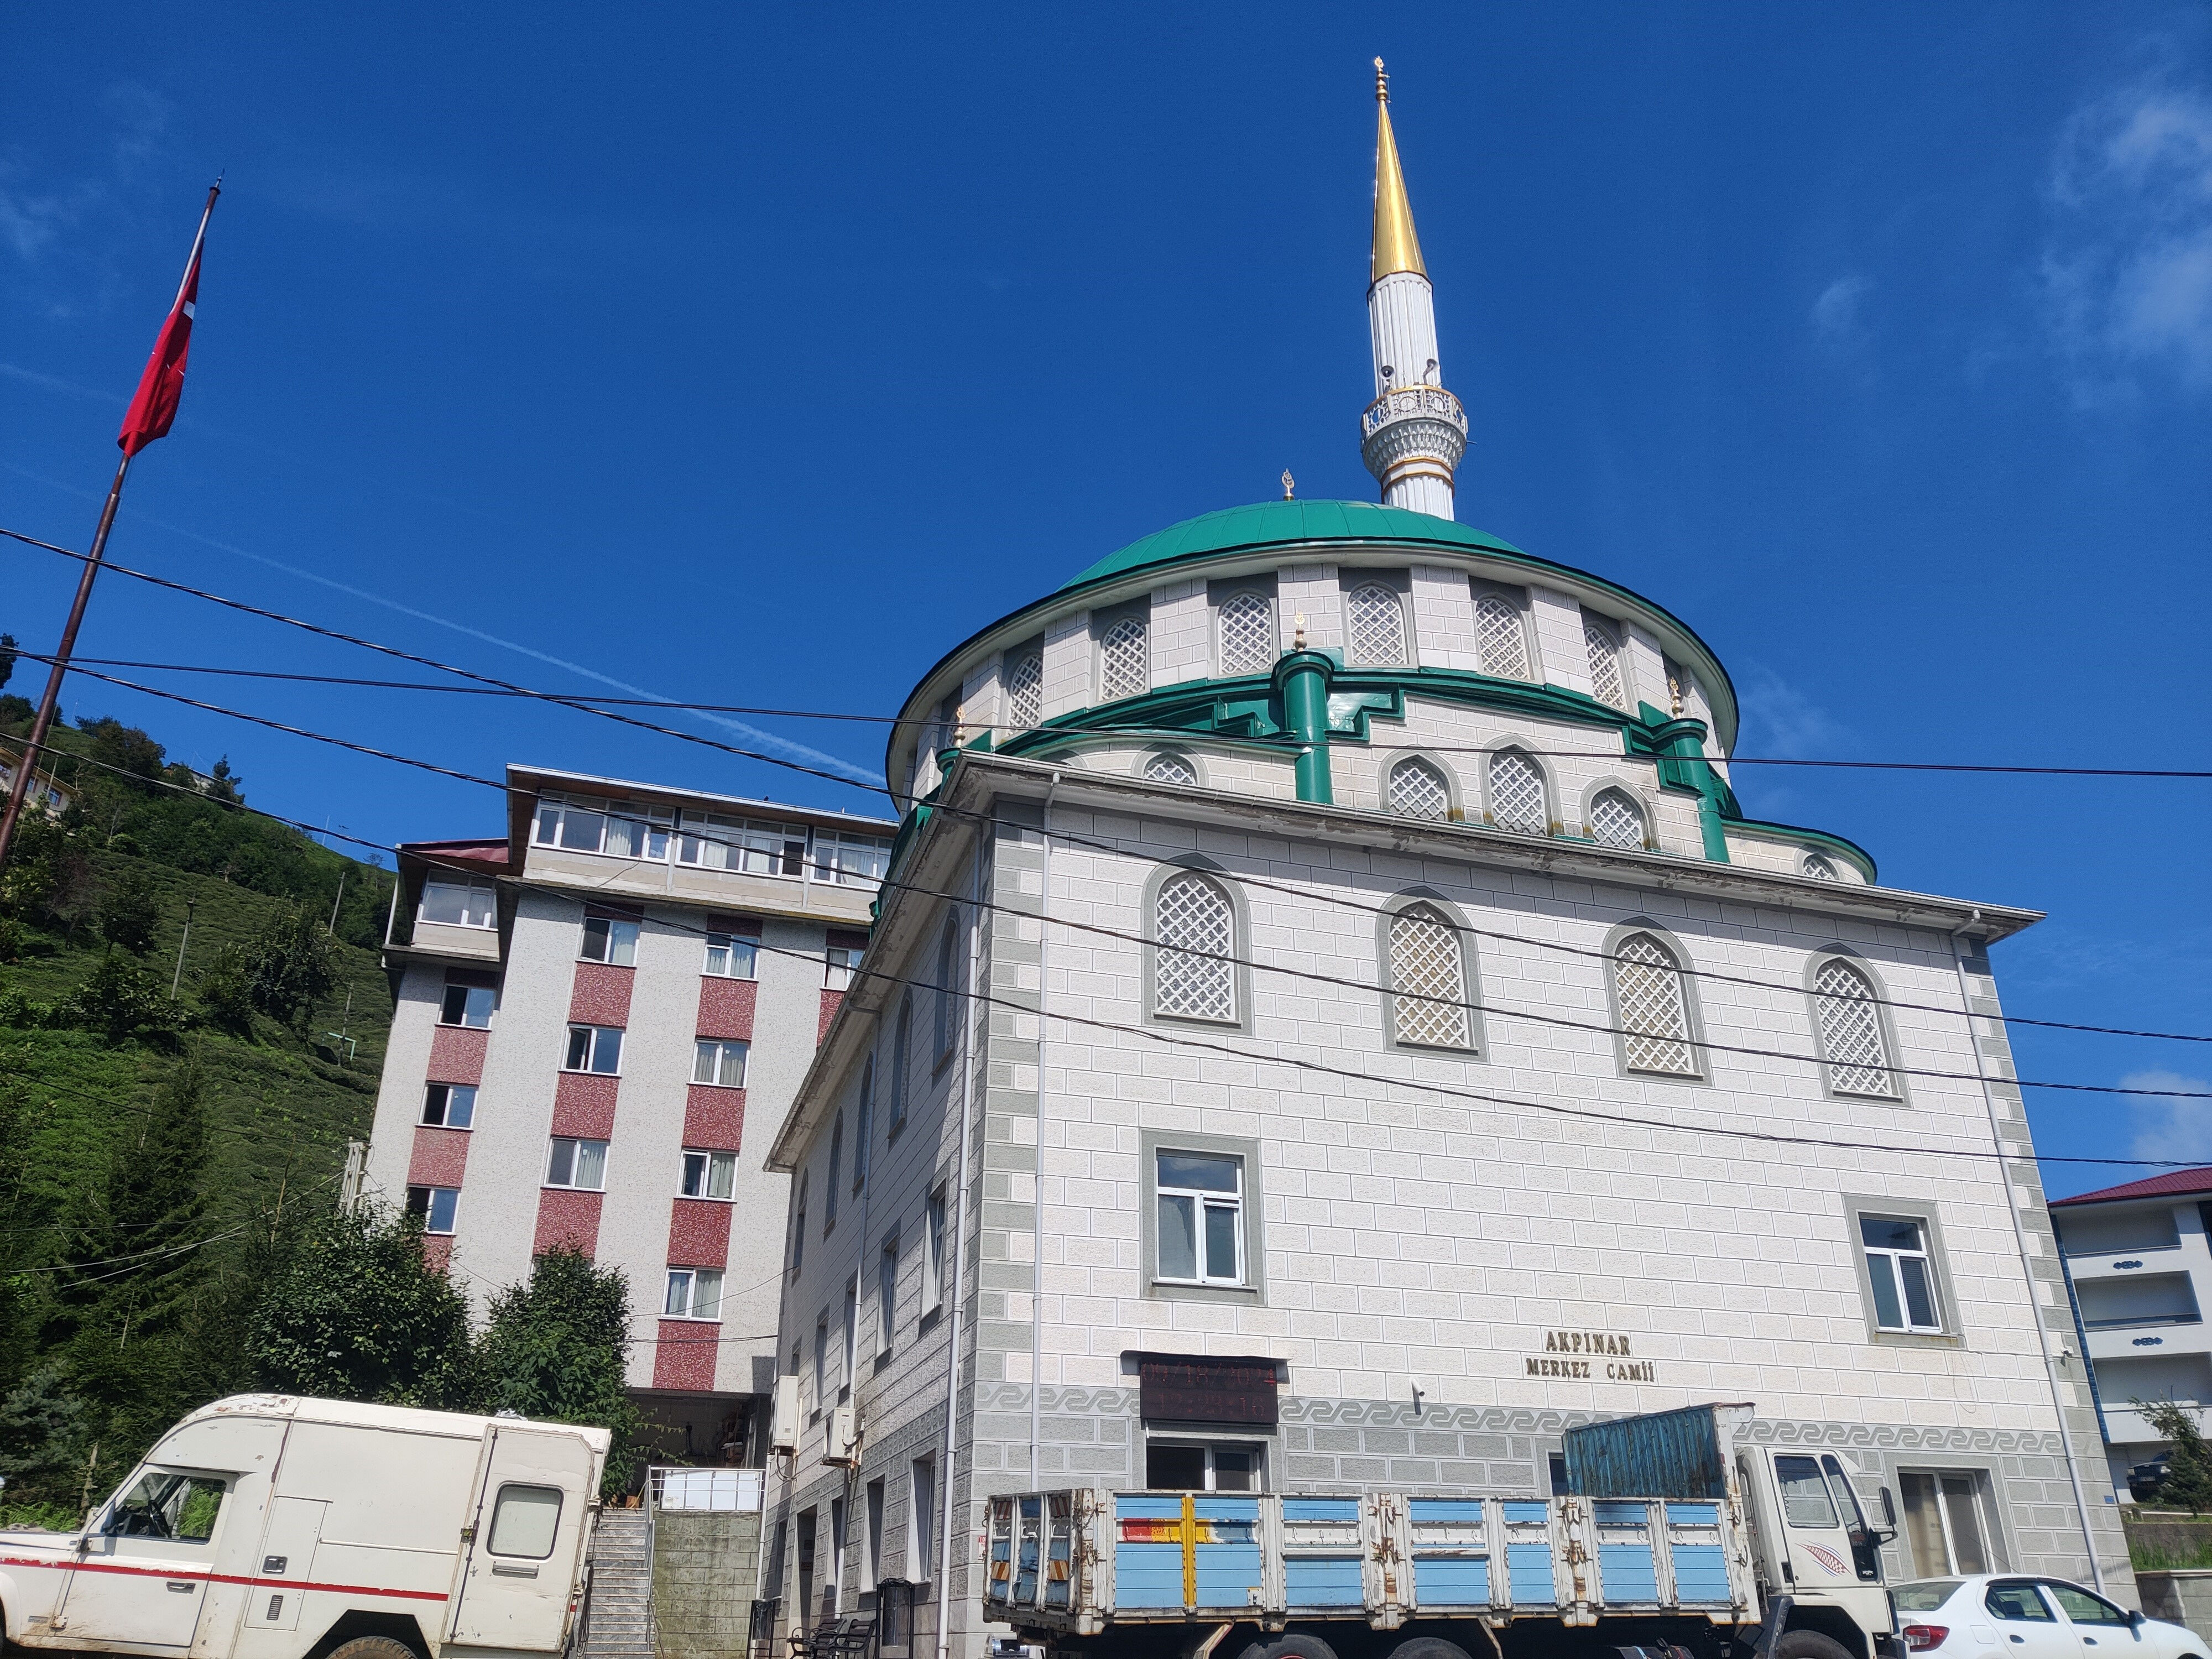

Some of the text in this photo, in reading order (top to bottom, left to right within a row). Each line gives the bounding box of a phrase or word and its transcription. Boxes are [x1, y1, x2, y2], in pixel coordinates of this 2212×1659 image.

[1546, 1331, 1631, 1356] AKPINAR
[1526, 1358, 1654, 1382] MERKEZ CAMİİ
